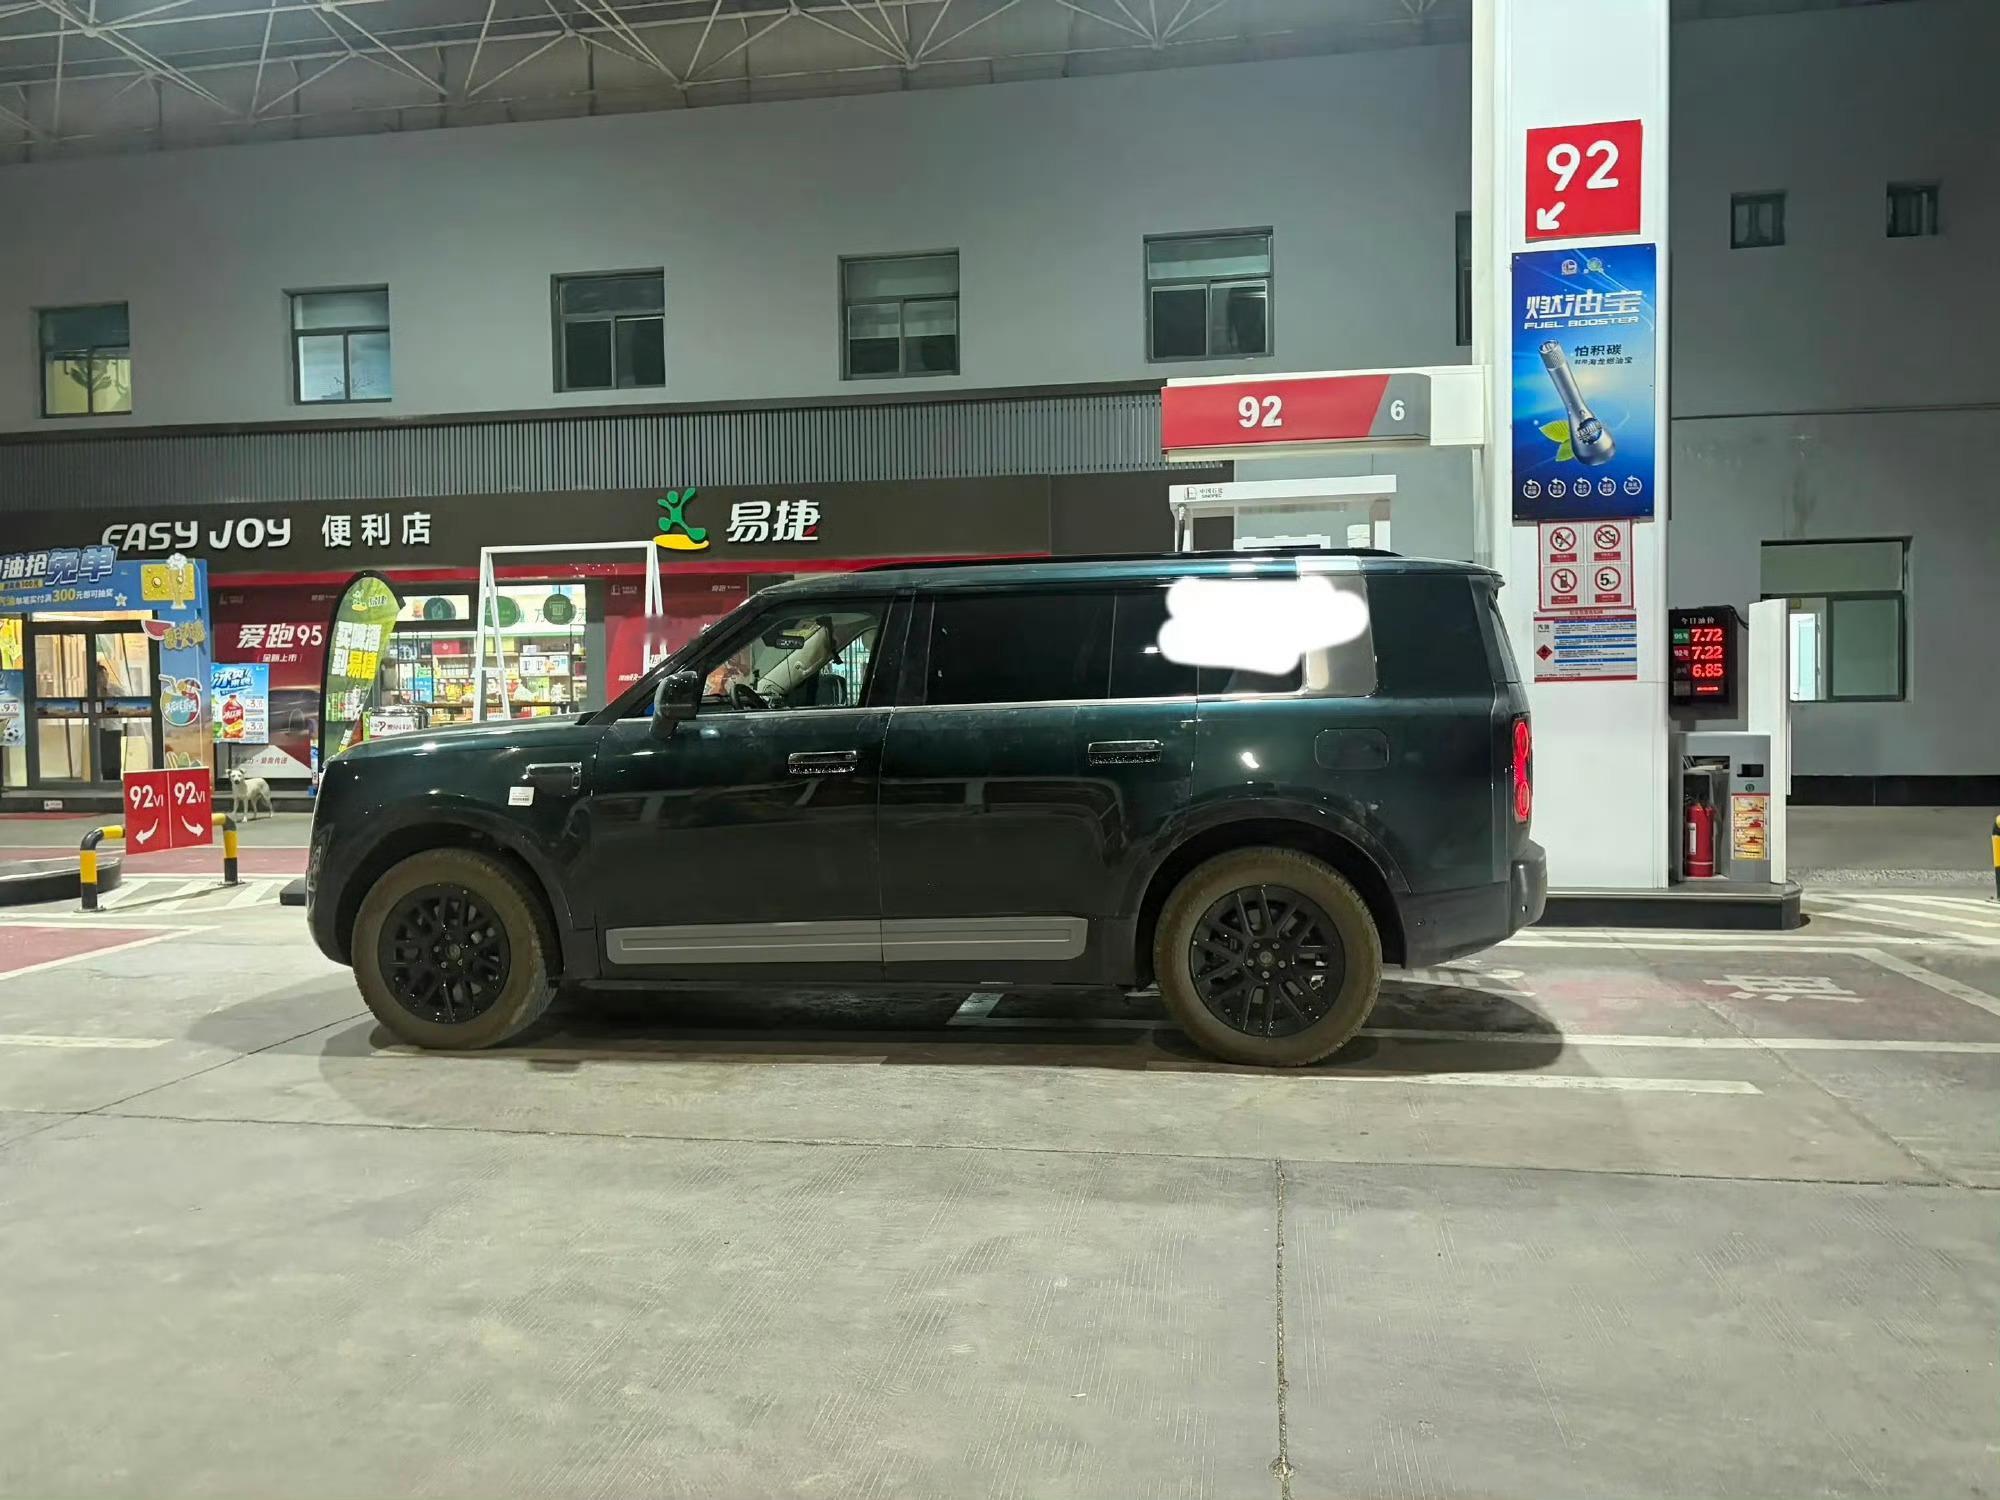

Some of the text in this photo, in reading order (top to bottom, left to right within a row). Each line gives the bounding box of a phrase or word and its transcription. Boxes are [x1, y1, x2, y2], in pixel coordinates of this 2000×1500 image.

[1546, 139, 1620, 192] 92
[1525, 289, 1643, 320] 燃油宝
[1524, 316, 1640, 330] FUEL BOOSTER
[1574, 344, 1622, 356] 怕积碳
[1238, 395, 1283, 428] 92
[1390, 400, 1405, 421] 6
[102, 517, 292, 551] EASY JOY
[321, 511, 432, 548] 便利店
[726, 500, 821, 543] 易捷
[0, 546, 116, 586] 油抢免单
[236, 623, 323, 649] 爱跑95
[1691, 628, 1723, 642] 7.72
[1691, 645, 1723, 660] 7.22
[1692, 663, 1724, 678] 6.85
